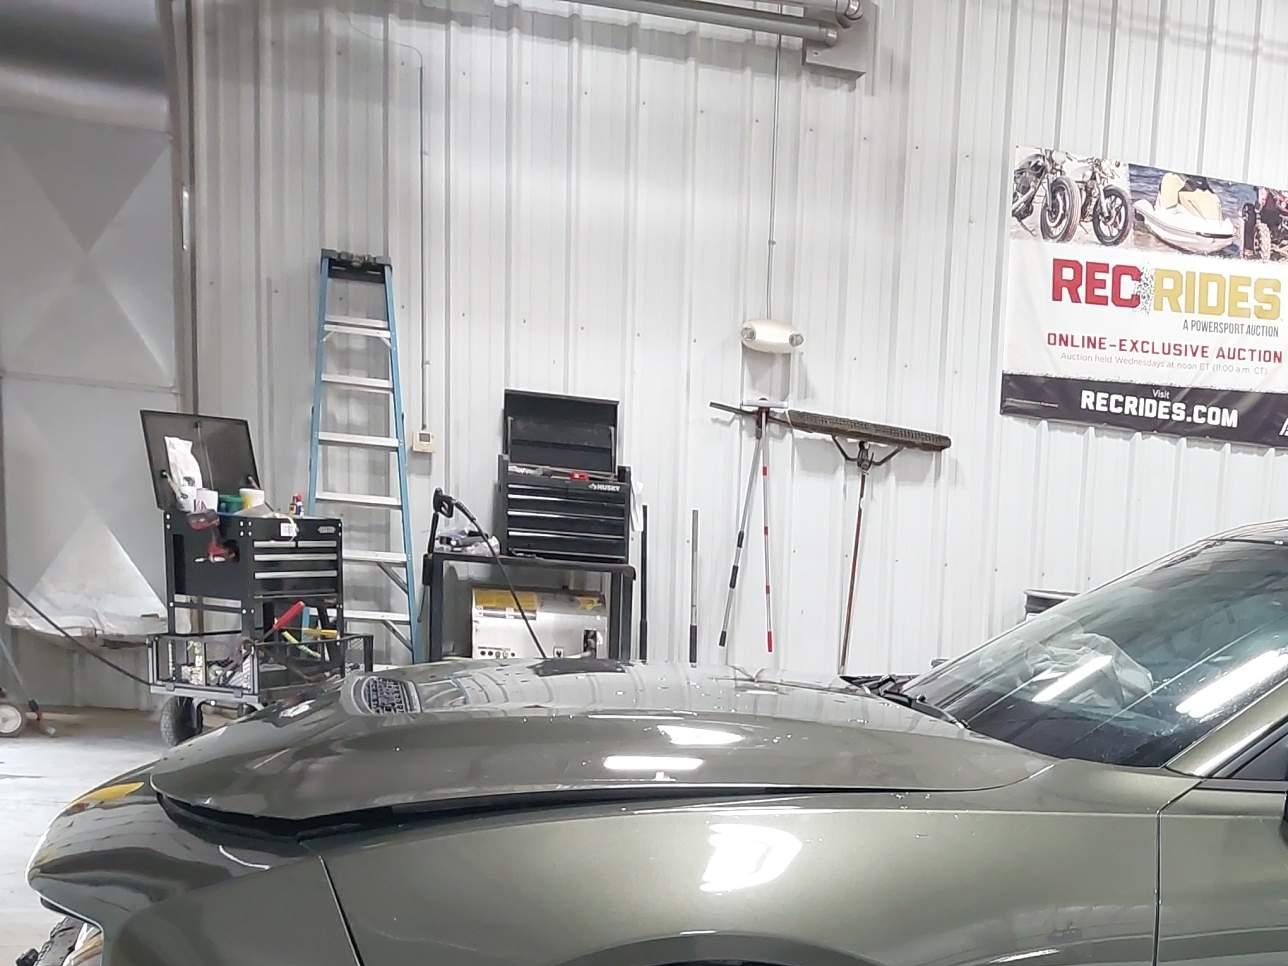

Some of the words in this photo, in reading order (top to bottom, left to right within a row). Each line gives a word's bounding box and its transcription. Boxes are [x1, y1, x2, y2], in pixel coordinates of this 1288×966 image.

[1153, 268, 1282, 320] RIDES
[1182, 319, 1189, 331] A
[1191, 320, 1244, 335] POWERSPORT
[1246, 324, 1279, 337] AUCTION
[1047, 332, 1209, 359] ONLINE-EXCLUSIVE
[1216, 346, 1283, 363] AUCTION
[1060, 353, 1092, 362] Auction
[1095, 354, 1113, 363] held
[1115, 356, 1164, 368] Wednesdays
[1153, 389, 1170, 399] Visit
[1081, 390, 1239, 428] RECRIDES.COM
